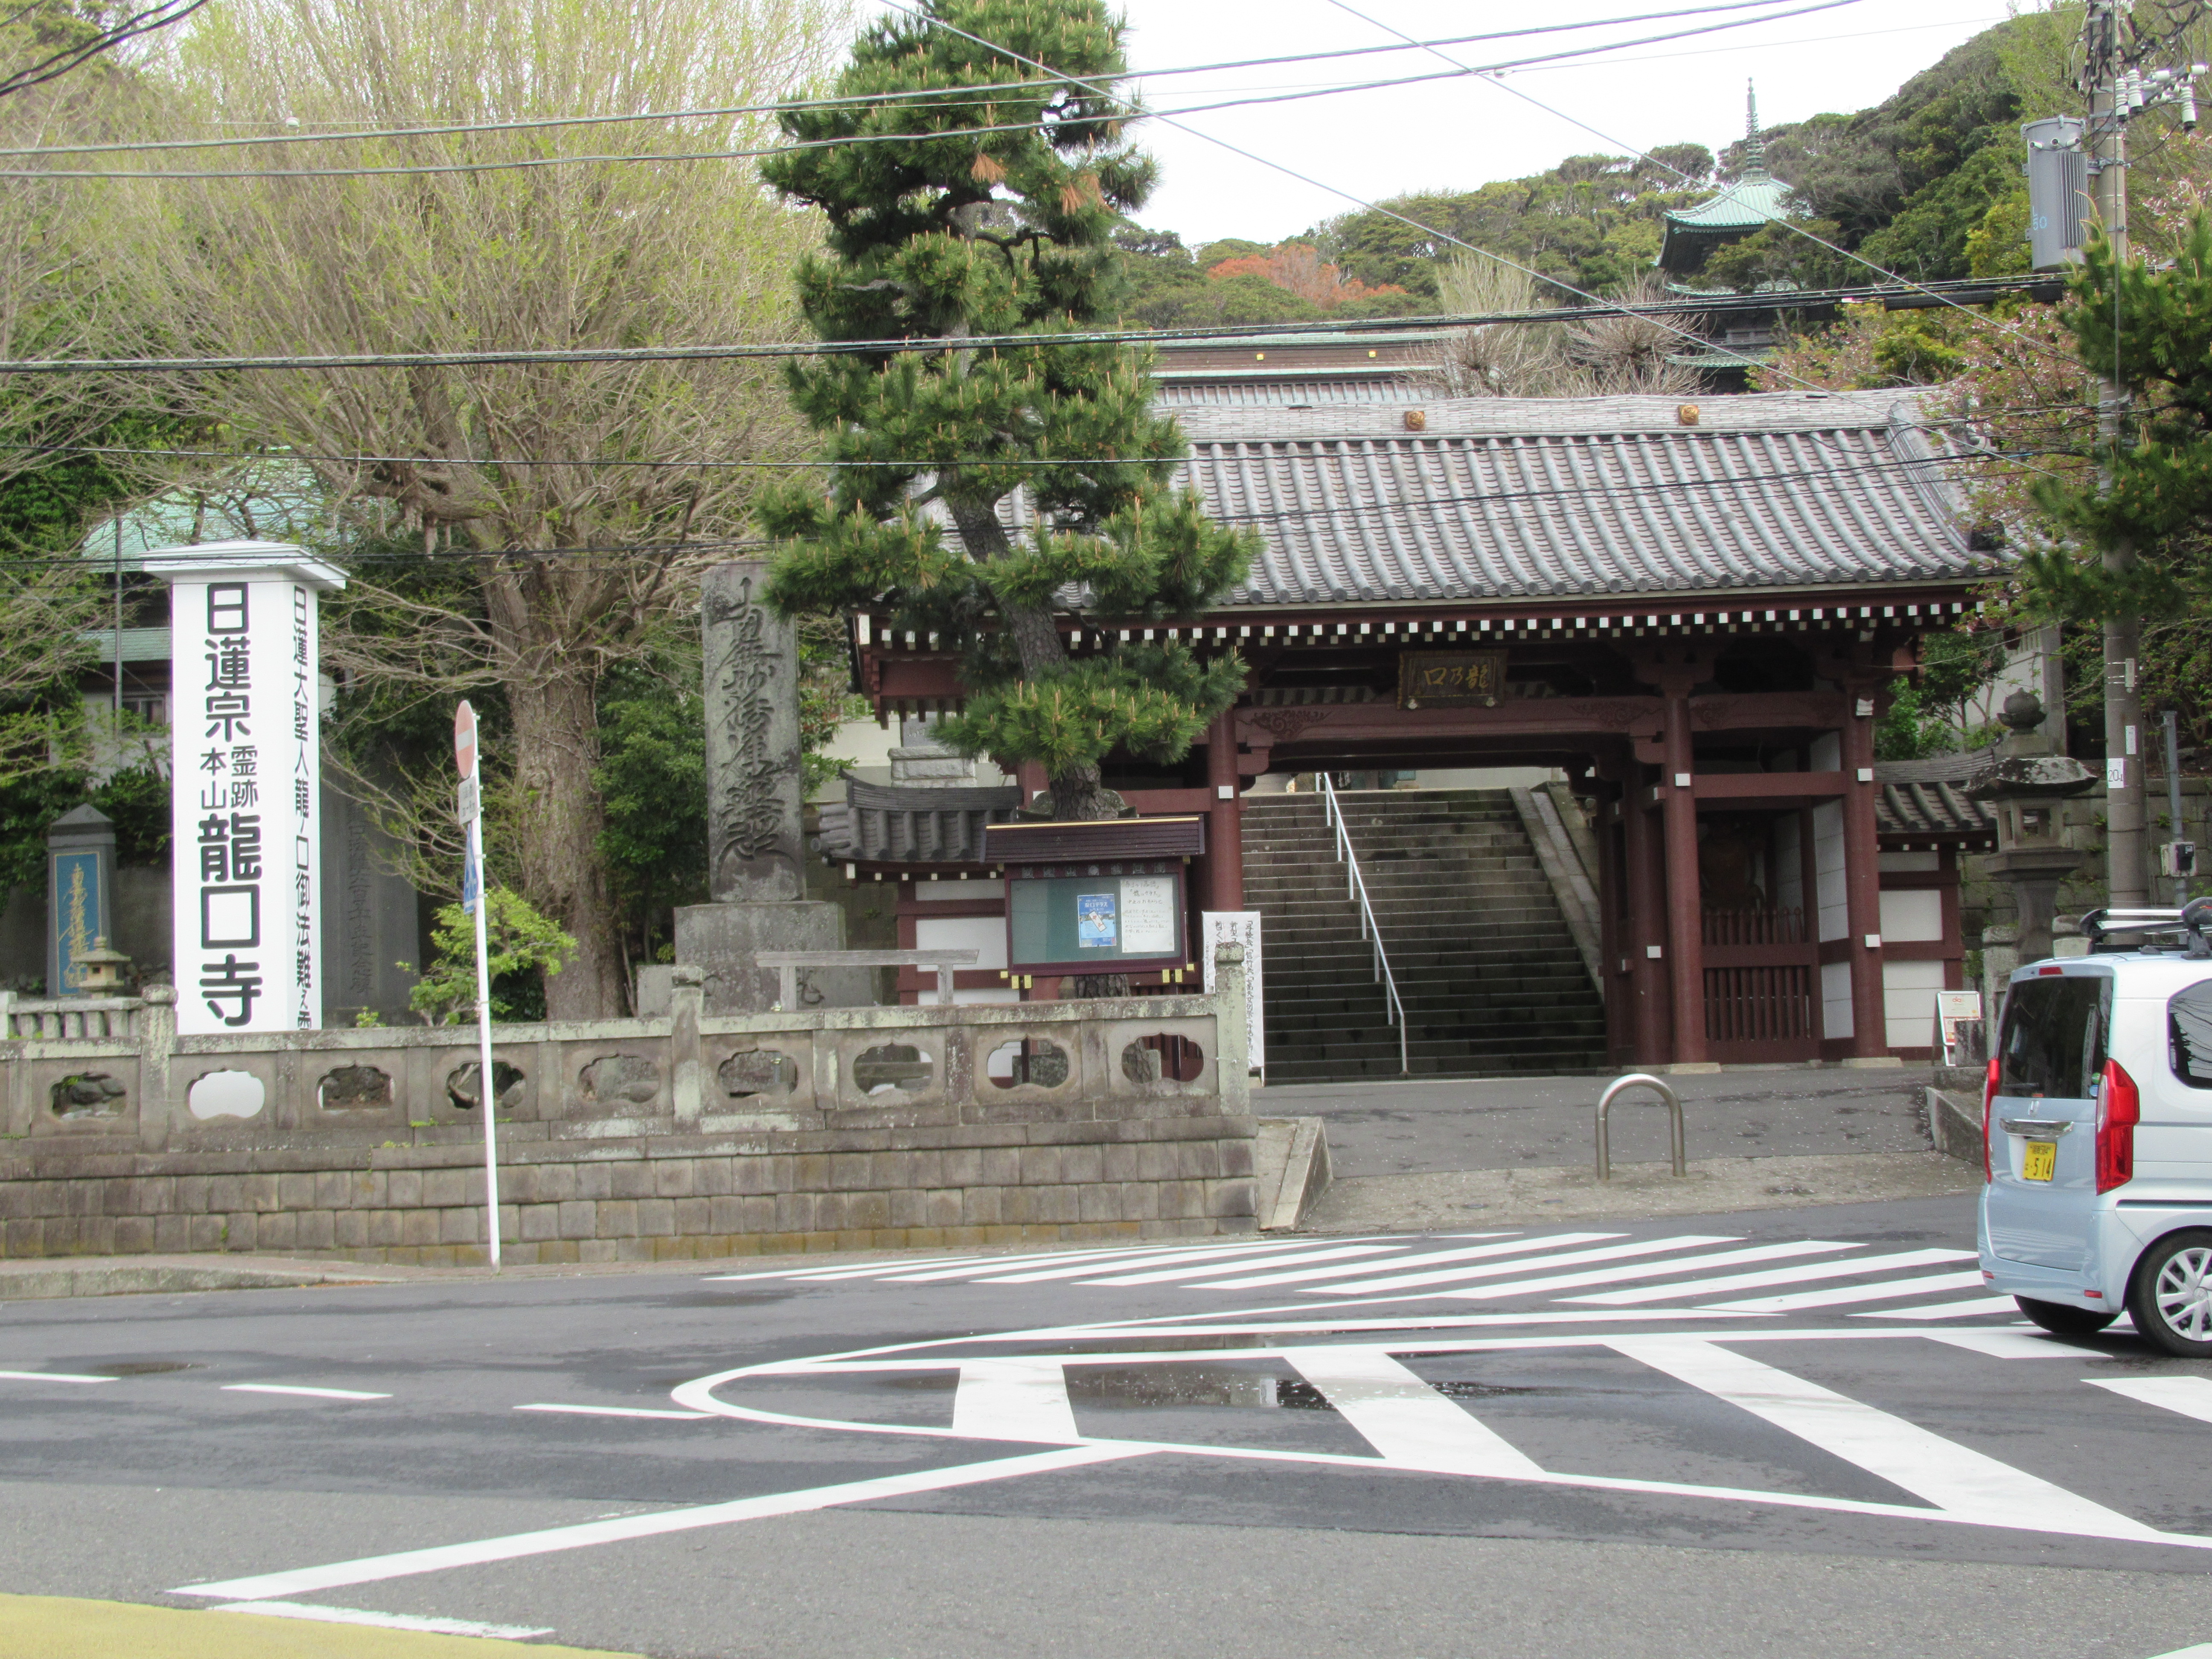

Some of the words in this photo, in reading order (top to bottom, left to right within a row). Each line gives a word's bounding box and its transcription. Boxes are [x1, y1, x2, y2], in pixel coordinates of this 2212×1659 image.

[2033, 216, 2047, 230] 50
[205, 581, 251, 742] 日蓮宗
[197, 812, 263, 1027] 龍口寺
